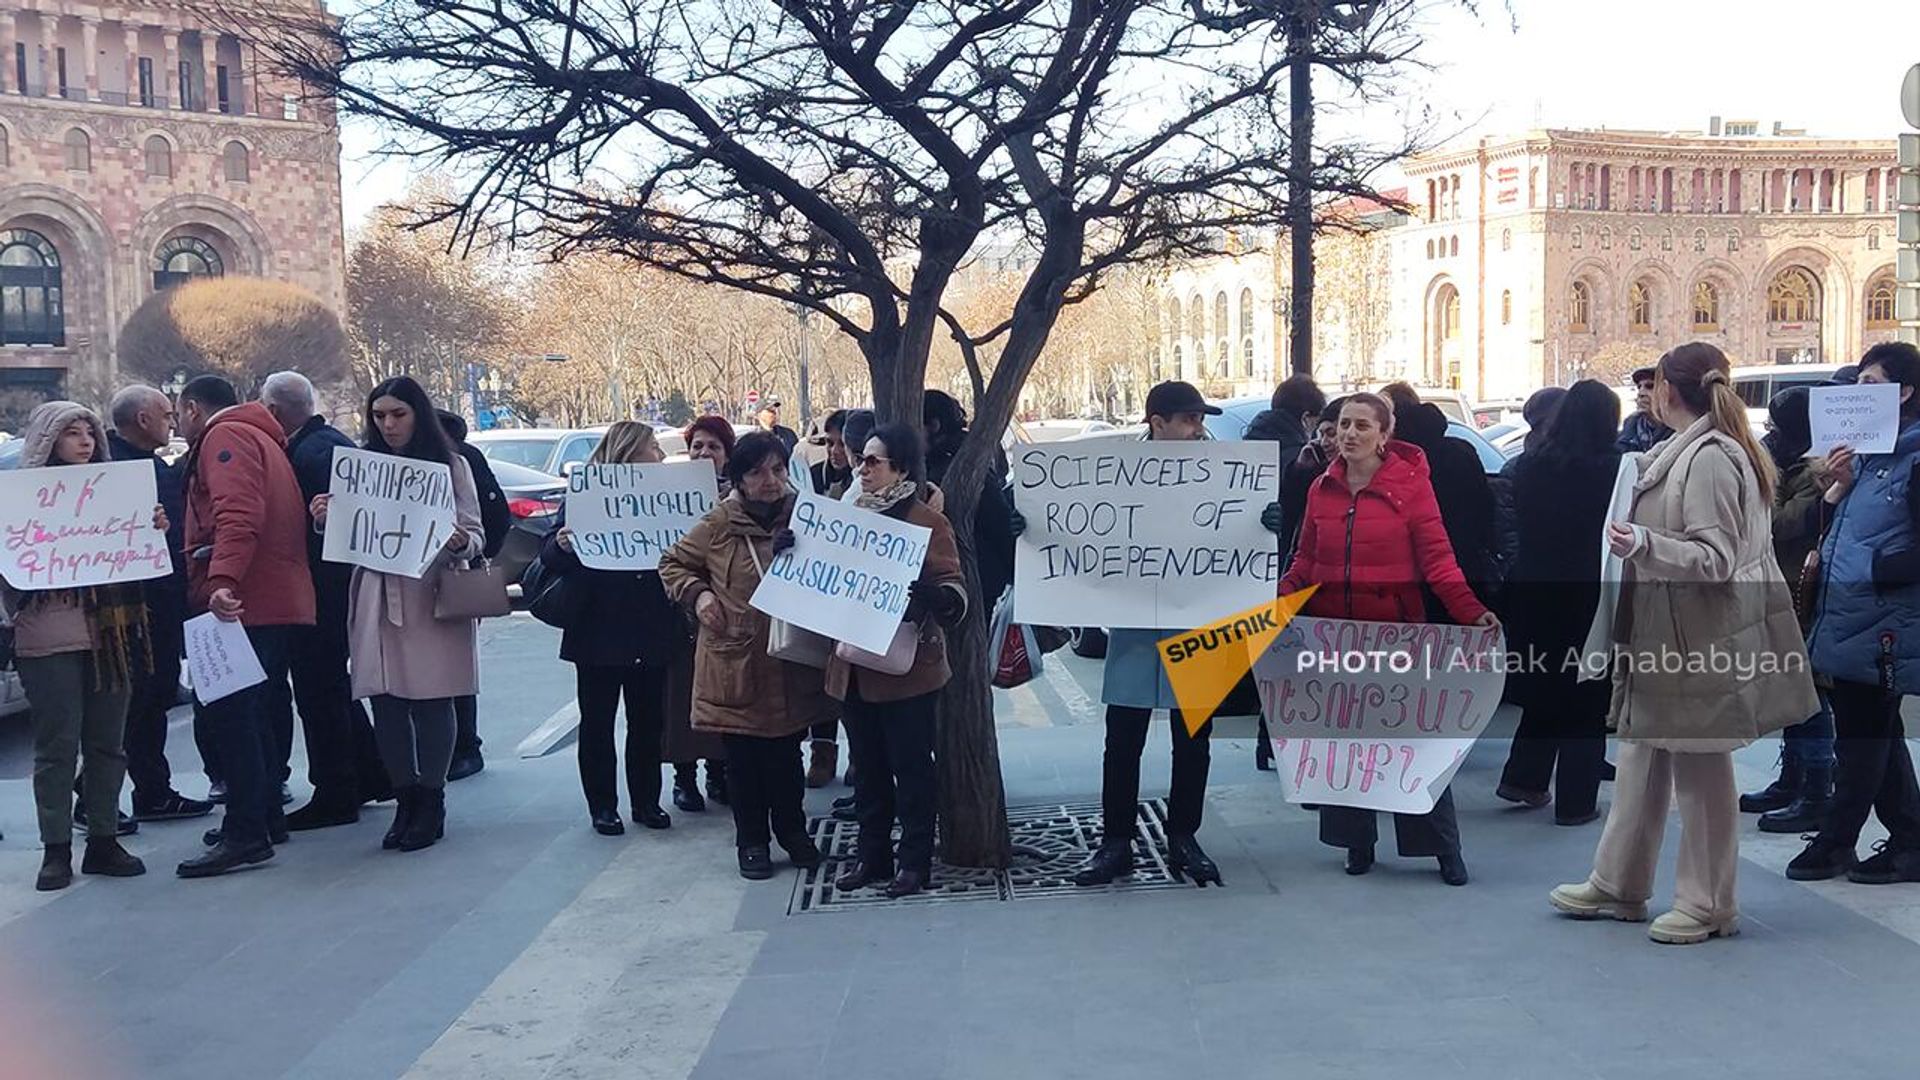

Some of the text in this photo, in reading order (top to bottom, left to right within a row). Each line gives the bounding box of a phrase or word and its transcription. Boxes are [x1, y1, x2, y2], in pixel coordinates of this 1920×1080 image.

[570, 463, 643, 493] ԵՐԿՐԻ
[1223, 460, 1276, 491] THE
[1046, 499, 1247, 539] ROOT OF
[1039, 544, 1279, 583] INDEPENDENCE
